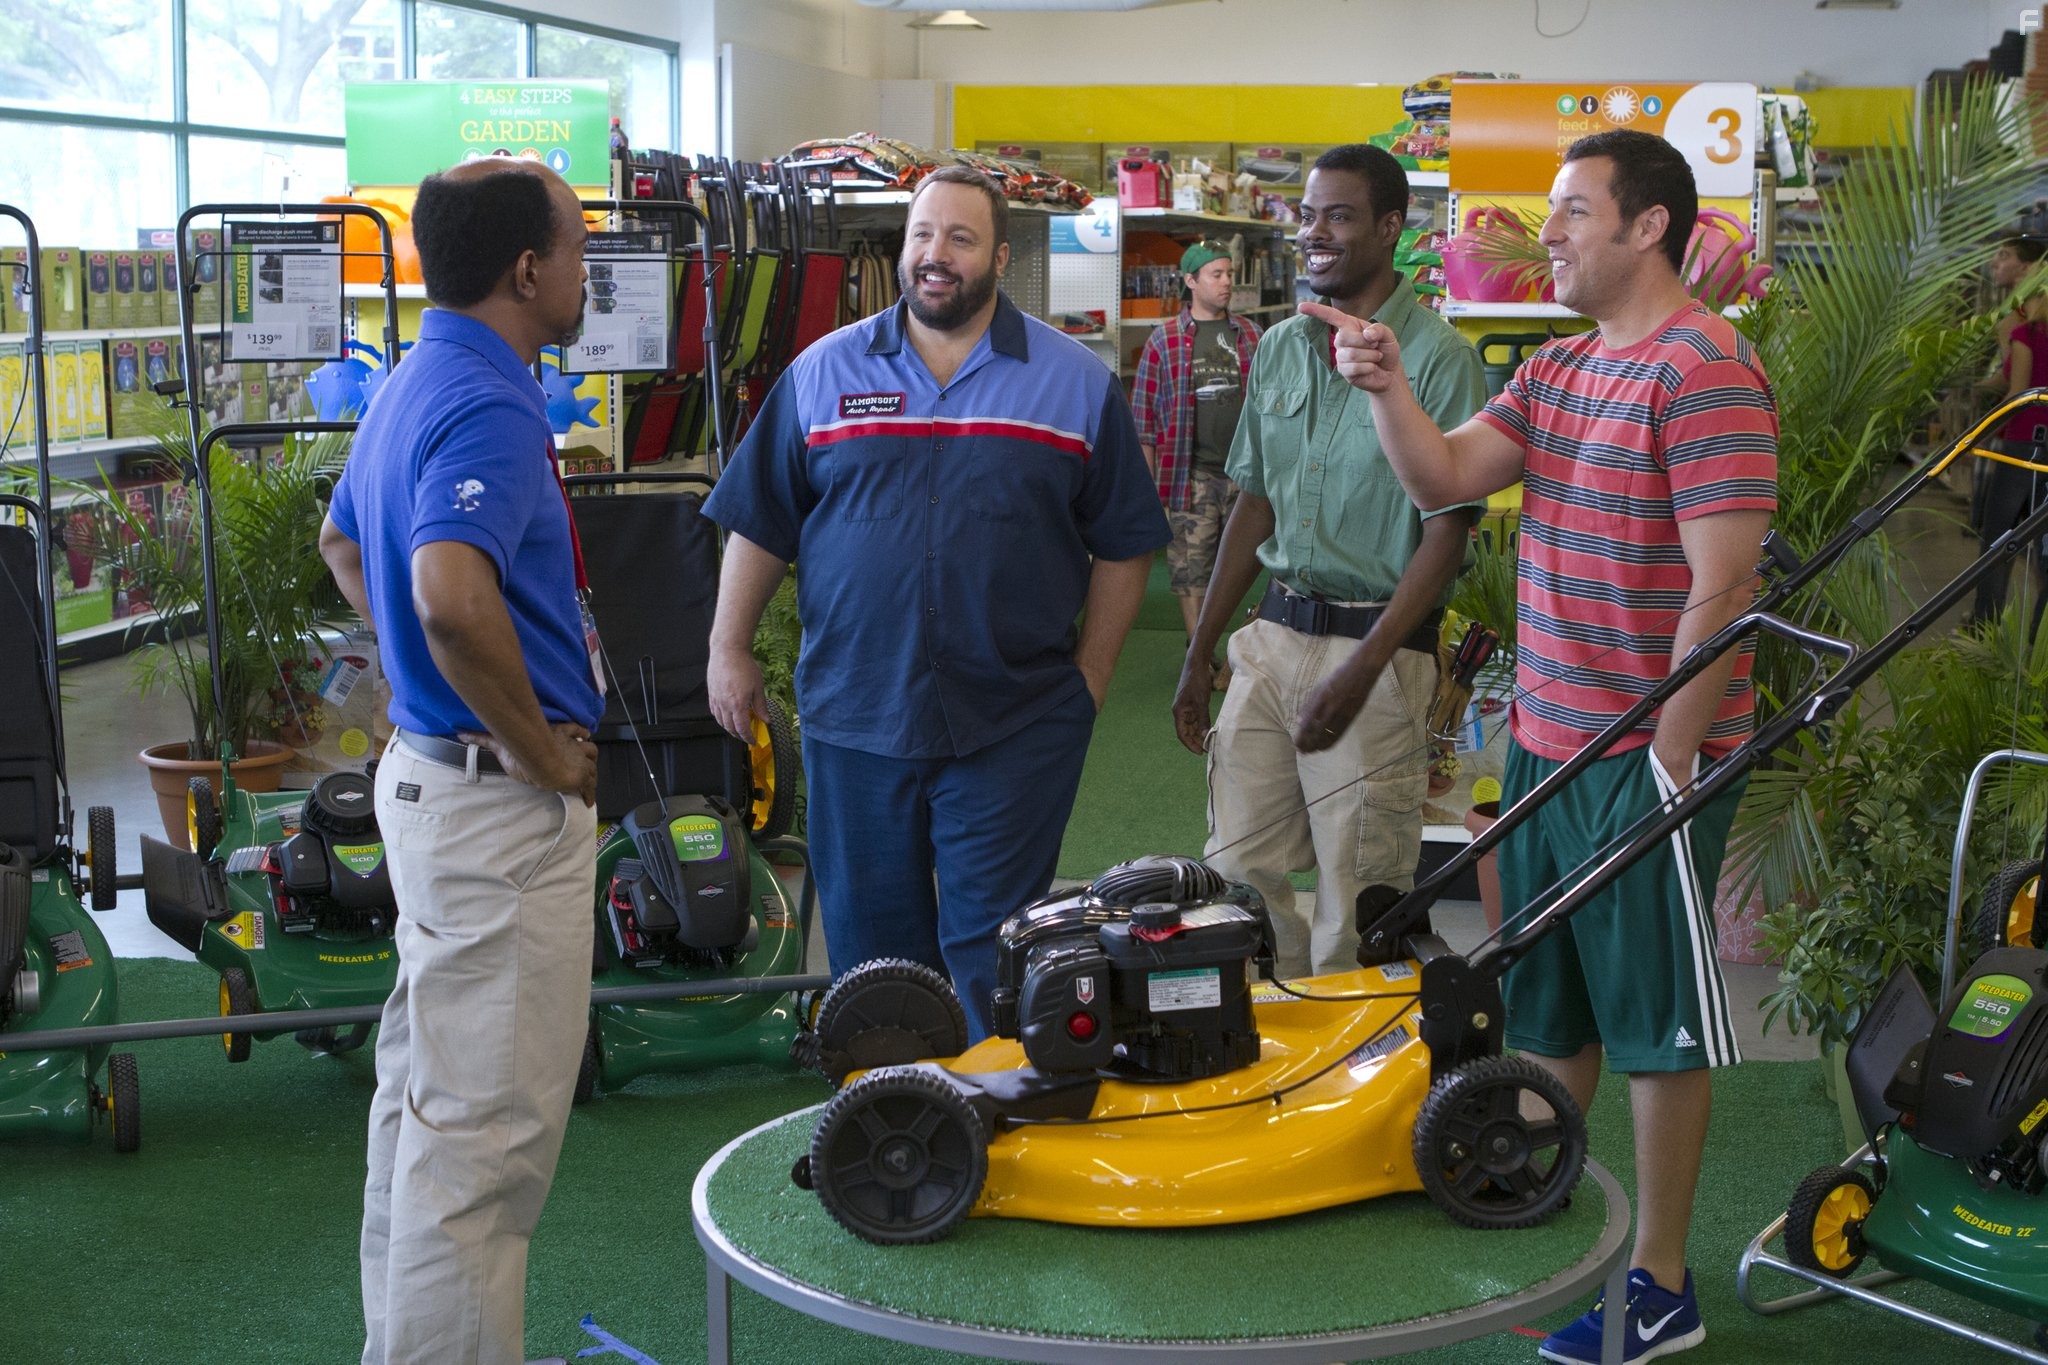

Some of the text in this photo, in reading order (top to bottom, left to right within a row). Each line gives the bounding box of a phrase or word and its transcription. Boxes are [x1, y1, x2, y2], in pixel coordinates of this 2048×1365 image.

[459, 87, 573, 105] 4 EASY STEPS
[490, 107, 542, 118] to the perfect
[460, 119, 572, 142] GARDEN
[1558, 118, 1589, 131] feed
[1704, 107, 1743, 165] 3
[1093, 210, 1112, 237] 4
[845, 396, 901, 406] LAMONSOFF
[846, 405, 897, 415] Auto Repair
[675, 823, 717, 832] WEEDEATER
[683, 833, 715, 843] 550
[254, 915, 263, 945] DANGER
[319, 953, 374, 963] WEEDEATER
[1977, 983, 2026, 1002] WEEDEATER
[1973, 999, 2011, 1016] 550
[1981, 1016, 2002, 1027] 5.50
[1675, 1039, 1697, 1048] adidas
[1952, 1204, 2037, 1237] WEEDEATER 22"
